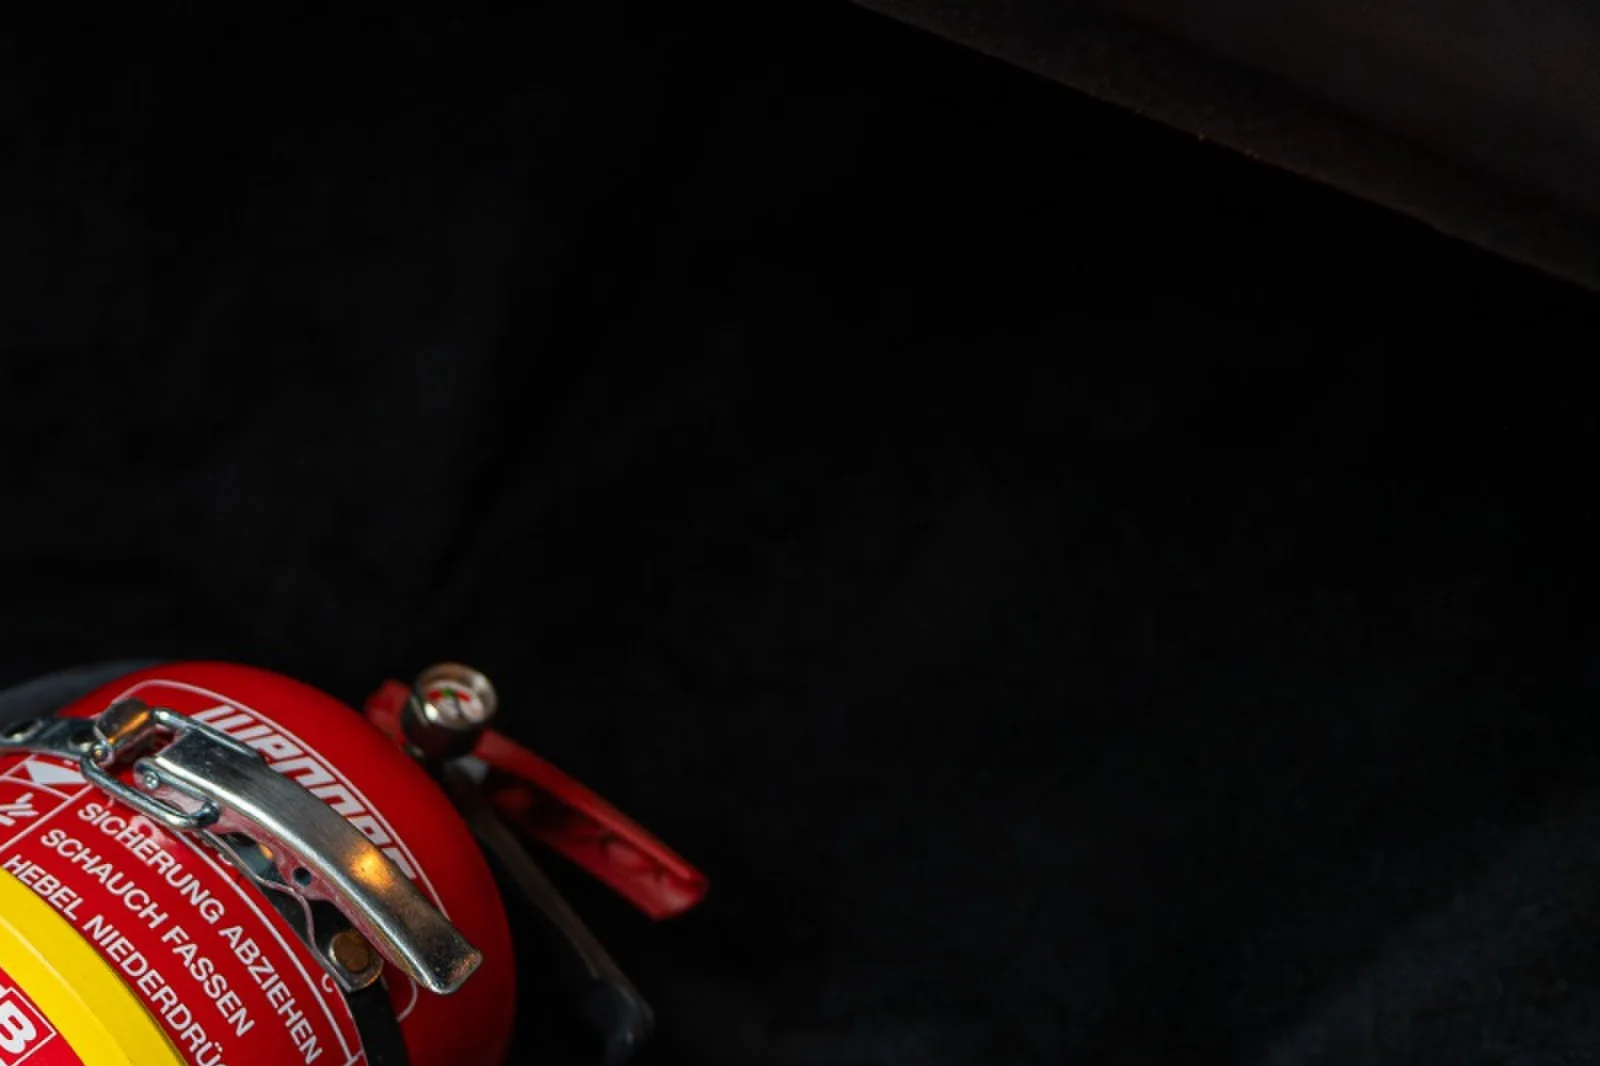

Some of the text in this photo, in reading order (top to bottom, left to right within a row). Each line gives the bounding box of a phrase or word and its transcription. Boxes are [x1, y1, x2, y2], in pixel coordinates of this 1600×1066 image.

[1, 854, 84, 921] HEBEL
[40, 829, 255, 1038] SCHAUCH FASSEN
[77, 802, 322, 1065] SICHERUNG ABZIEHEN
